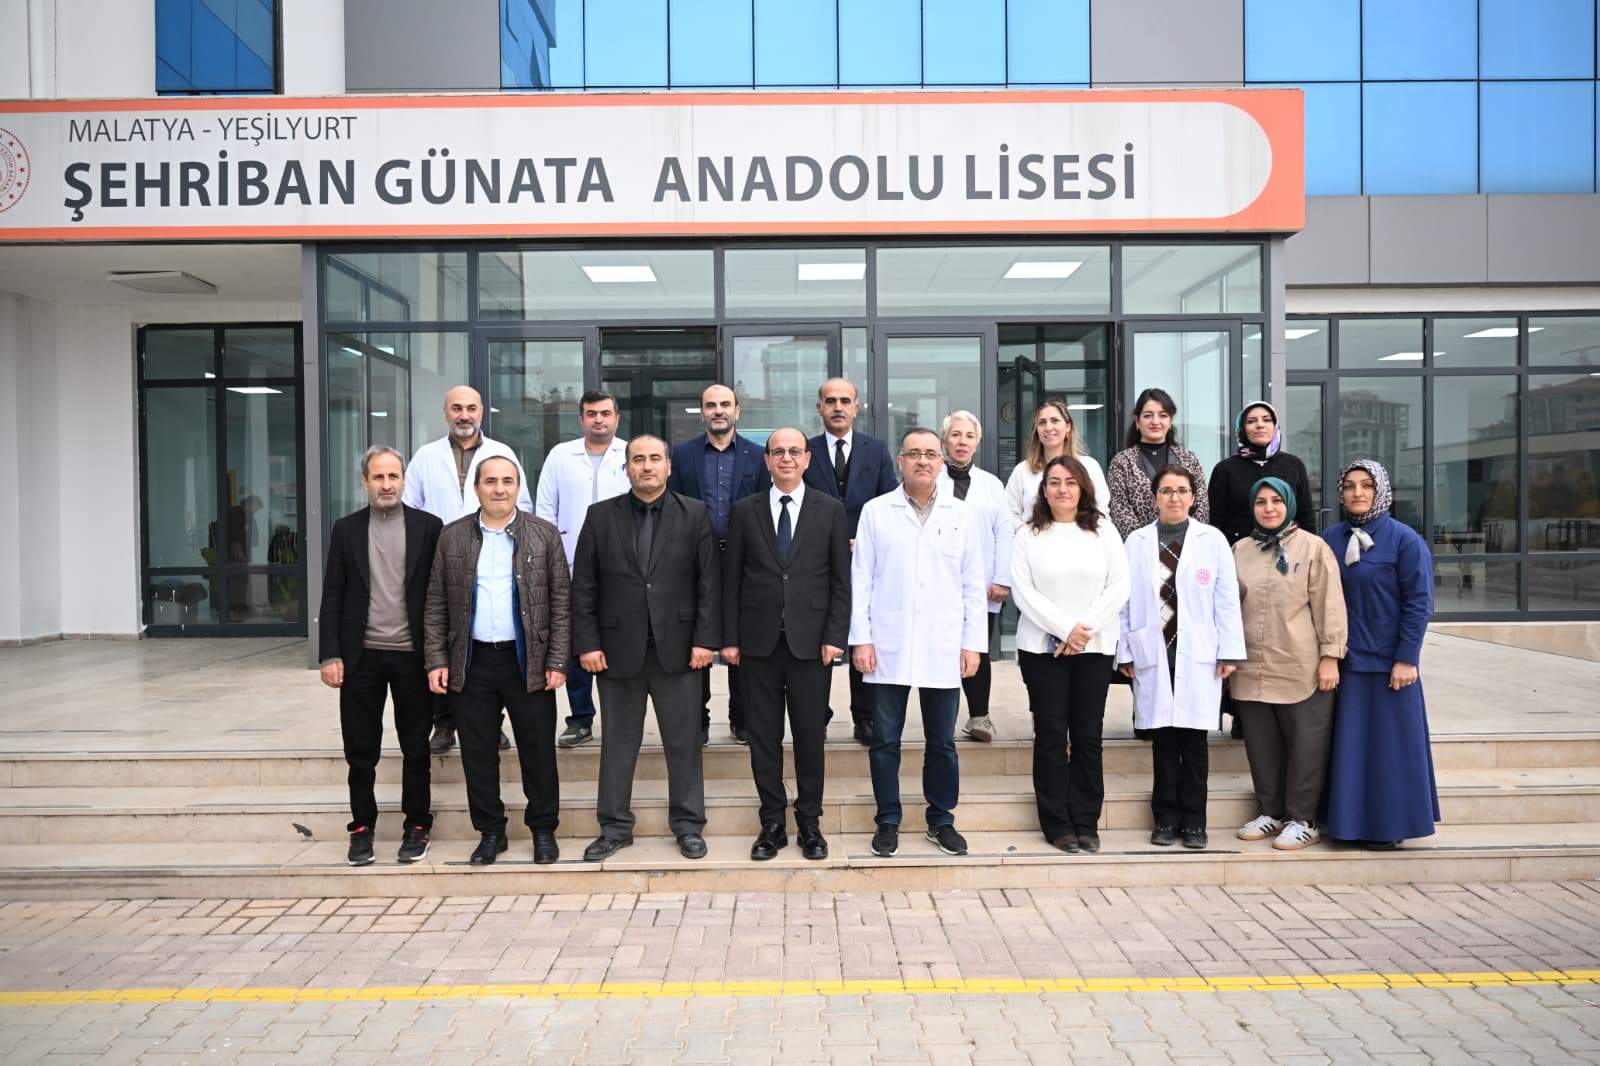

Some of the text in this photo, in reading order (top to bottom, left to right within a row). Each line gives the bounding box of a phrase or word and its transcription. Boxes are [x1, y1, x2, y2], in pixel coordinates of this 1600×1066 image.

[69, 118, 195, 142] MALATYA
[217, 112, 357, 147] YEŞİLYURT
[64, 142, 1135, 222] ŞEHRİBAN GÜNATA ANADOLU LİSESİ
